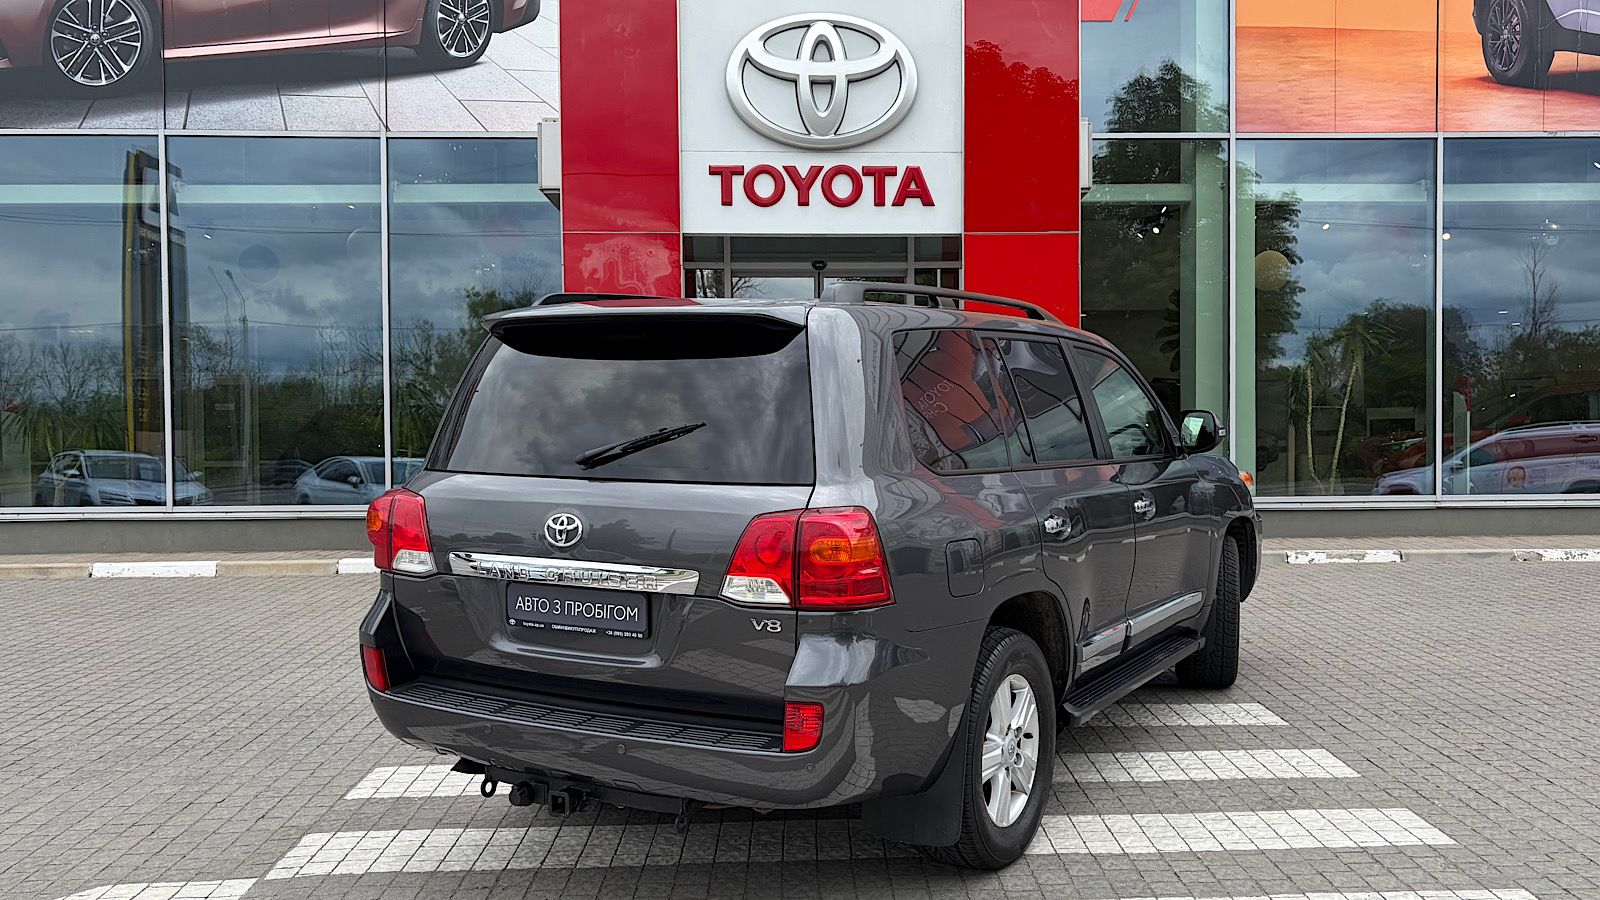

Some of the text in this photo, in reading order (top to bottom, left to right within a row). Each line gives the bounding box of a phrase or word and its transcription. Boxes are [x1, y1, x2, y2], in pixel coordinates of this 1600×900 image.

[709, 164, 935, 207] TOYOTA
[475, 560, 658, 591] LAND CRUISER
[515, 596, 550, 613] АВТО
[564, 601, 639, 622] ПРОБІГОМ
[750, 618, 782, 632] V8
